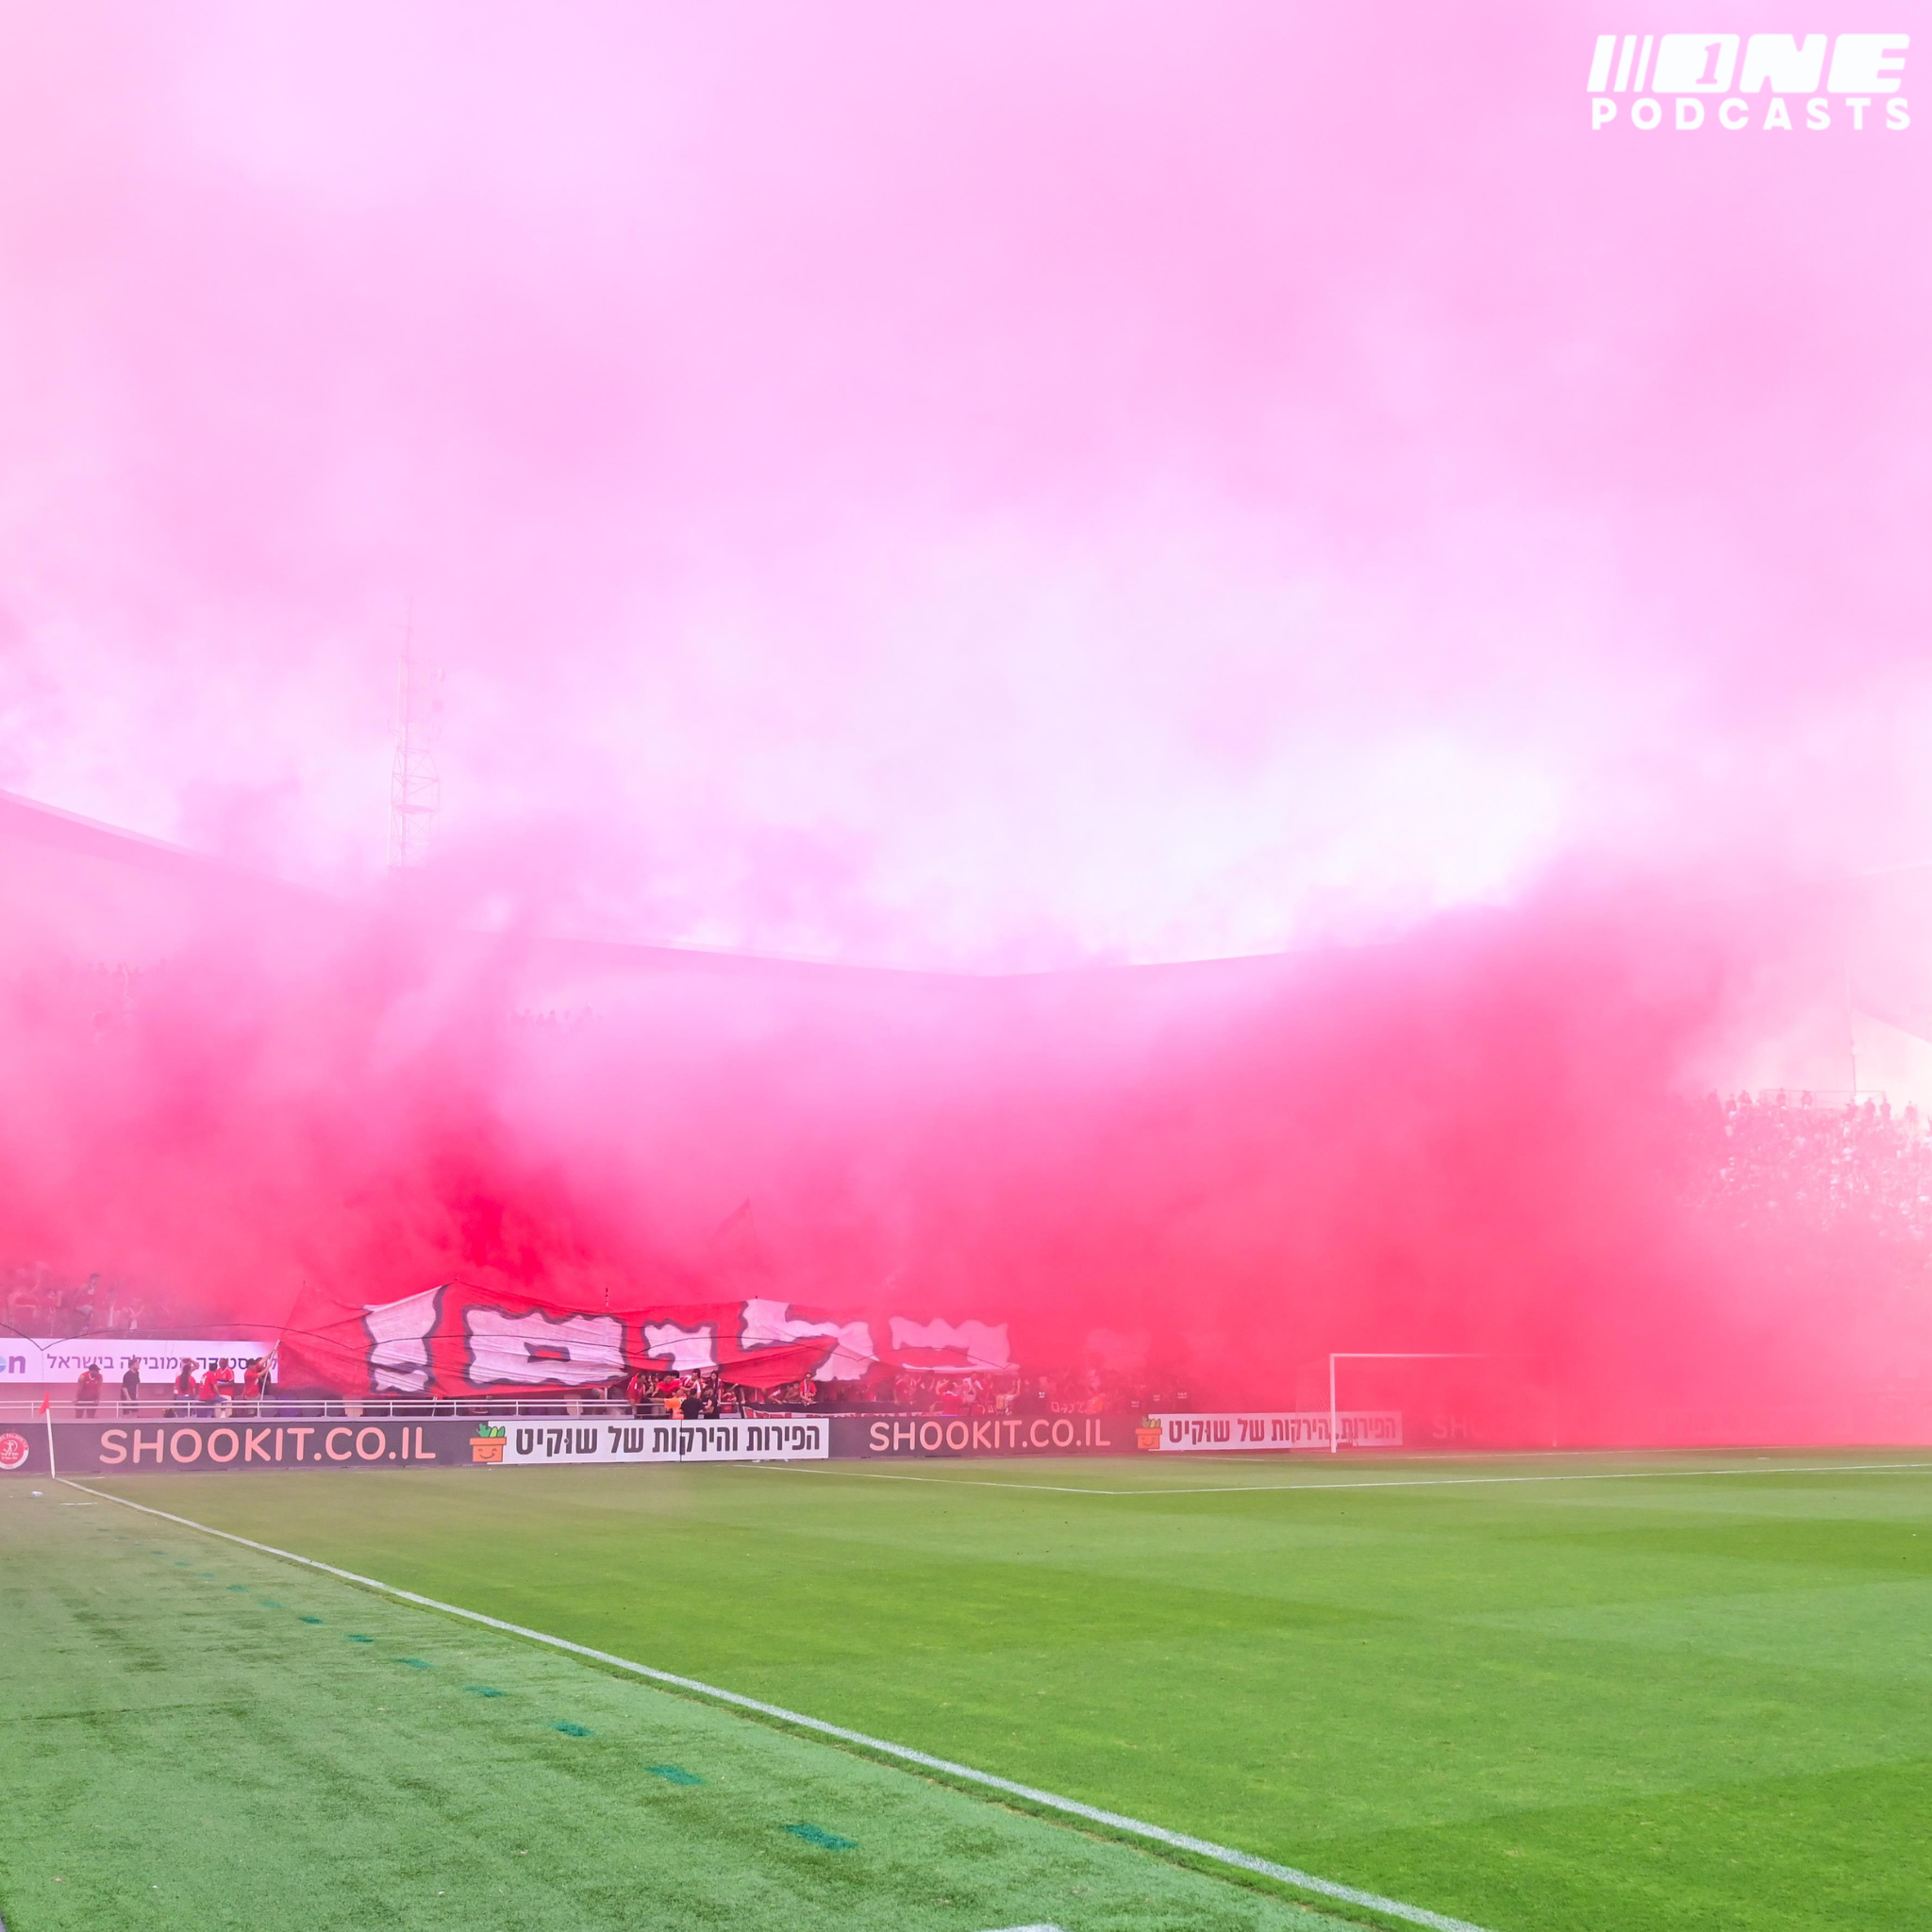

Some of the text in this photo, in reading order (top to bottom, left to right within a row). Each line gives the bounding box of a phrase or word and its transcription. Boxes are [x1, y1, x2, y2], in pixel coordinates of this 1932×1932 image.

[47, 1353, 114, 1369] בישראל
[608, 1425, 644, 1454] של
[652, 1425, 739, 1455] והירקות
[746, 1425, 820, 1451] הפירות
[869, 1418, 1111, 1452] SHOOKIT.CO.IL
[1237, 1418, 1265, 1441] של
[99, 1426, 437, 1465] SHOOKIT.CO.IL
